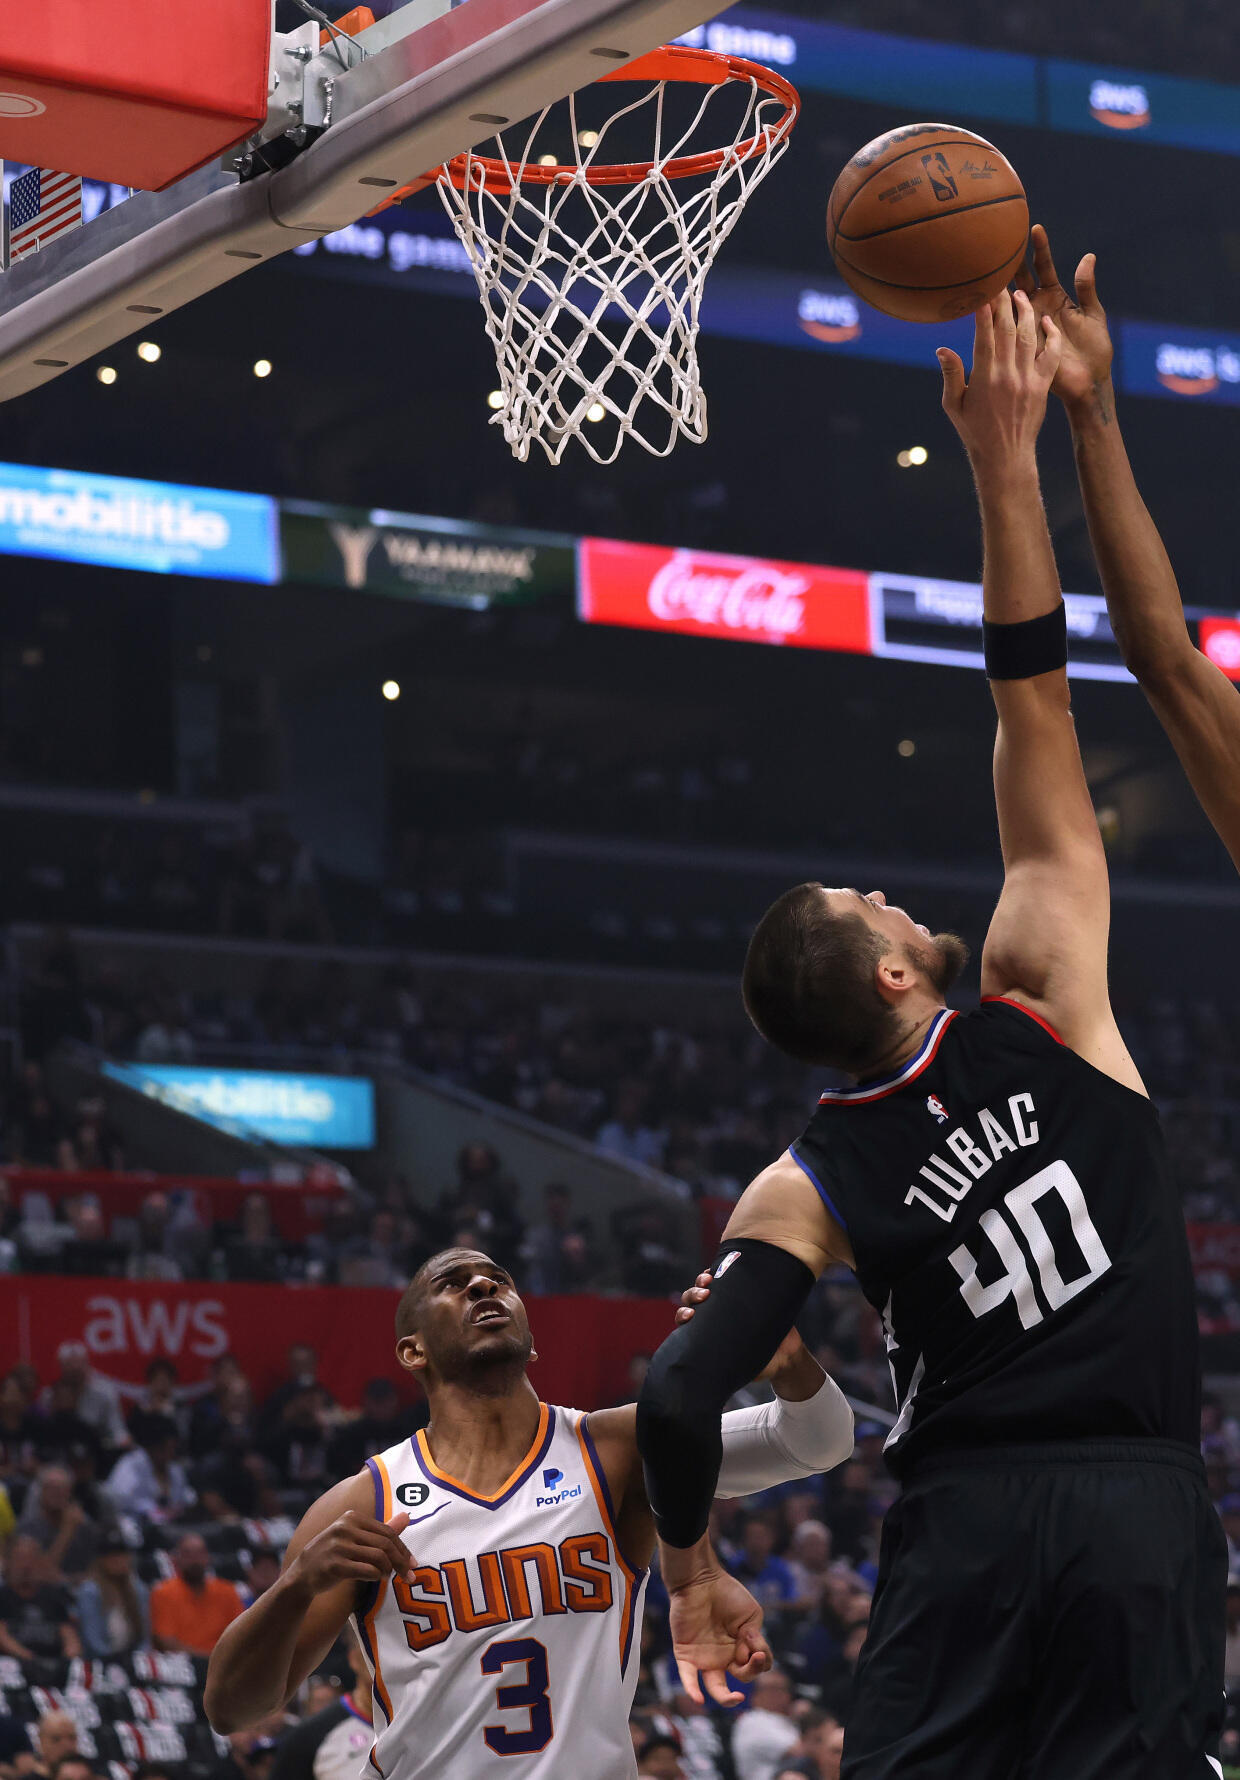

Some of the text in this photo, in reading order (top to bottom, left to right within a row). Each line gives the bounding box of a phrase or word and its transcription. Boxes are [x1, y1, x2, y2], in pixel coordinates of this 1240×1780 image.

[1089, 80, 1149, 115] aws
[798, 291, 860, 327] aws
[1157, 344, 1214, 380] aws
[1216, 346, 1240, 382] is
[904, 1092, 1040, 1223] ZUBAC
[947, 1159, 1113, 1331] 40
[84, 1296, 230, 1357] aws
[404, 1486, 422, 1503] 6
[536, 1485, 582, 1507] PayPal
[392, 1531, 613, 1653] SUNS
[480, 1637, 554, 1757] 3
